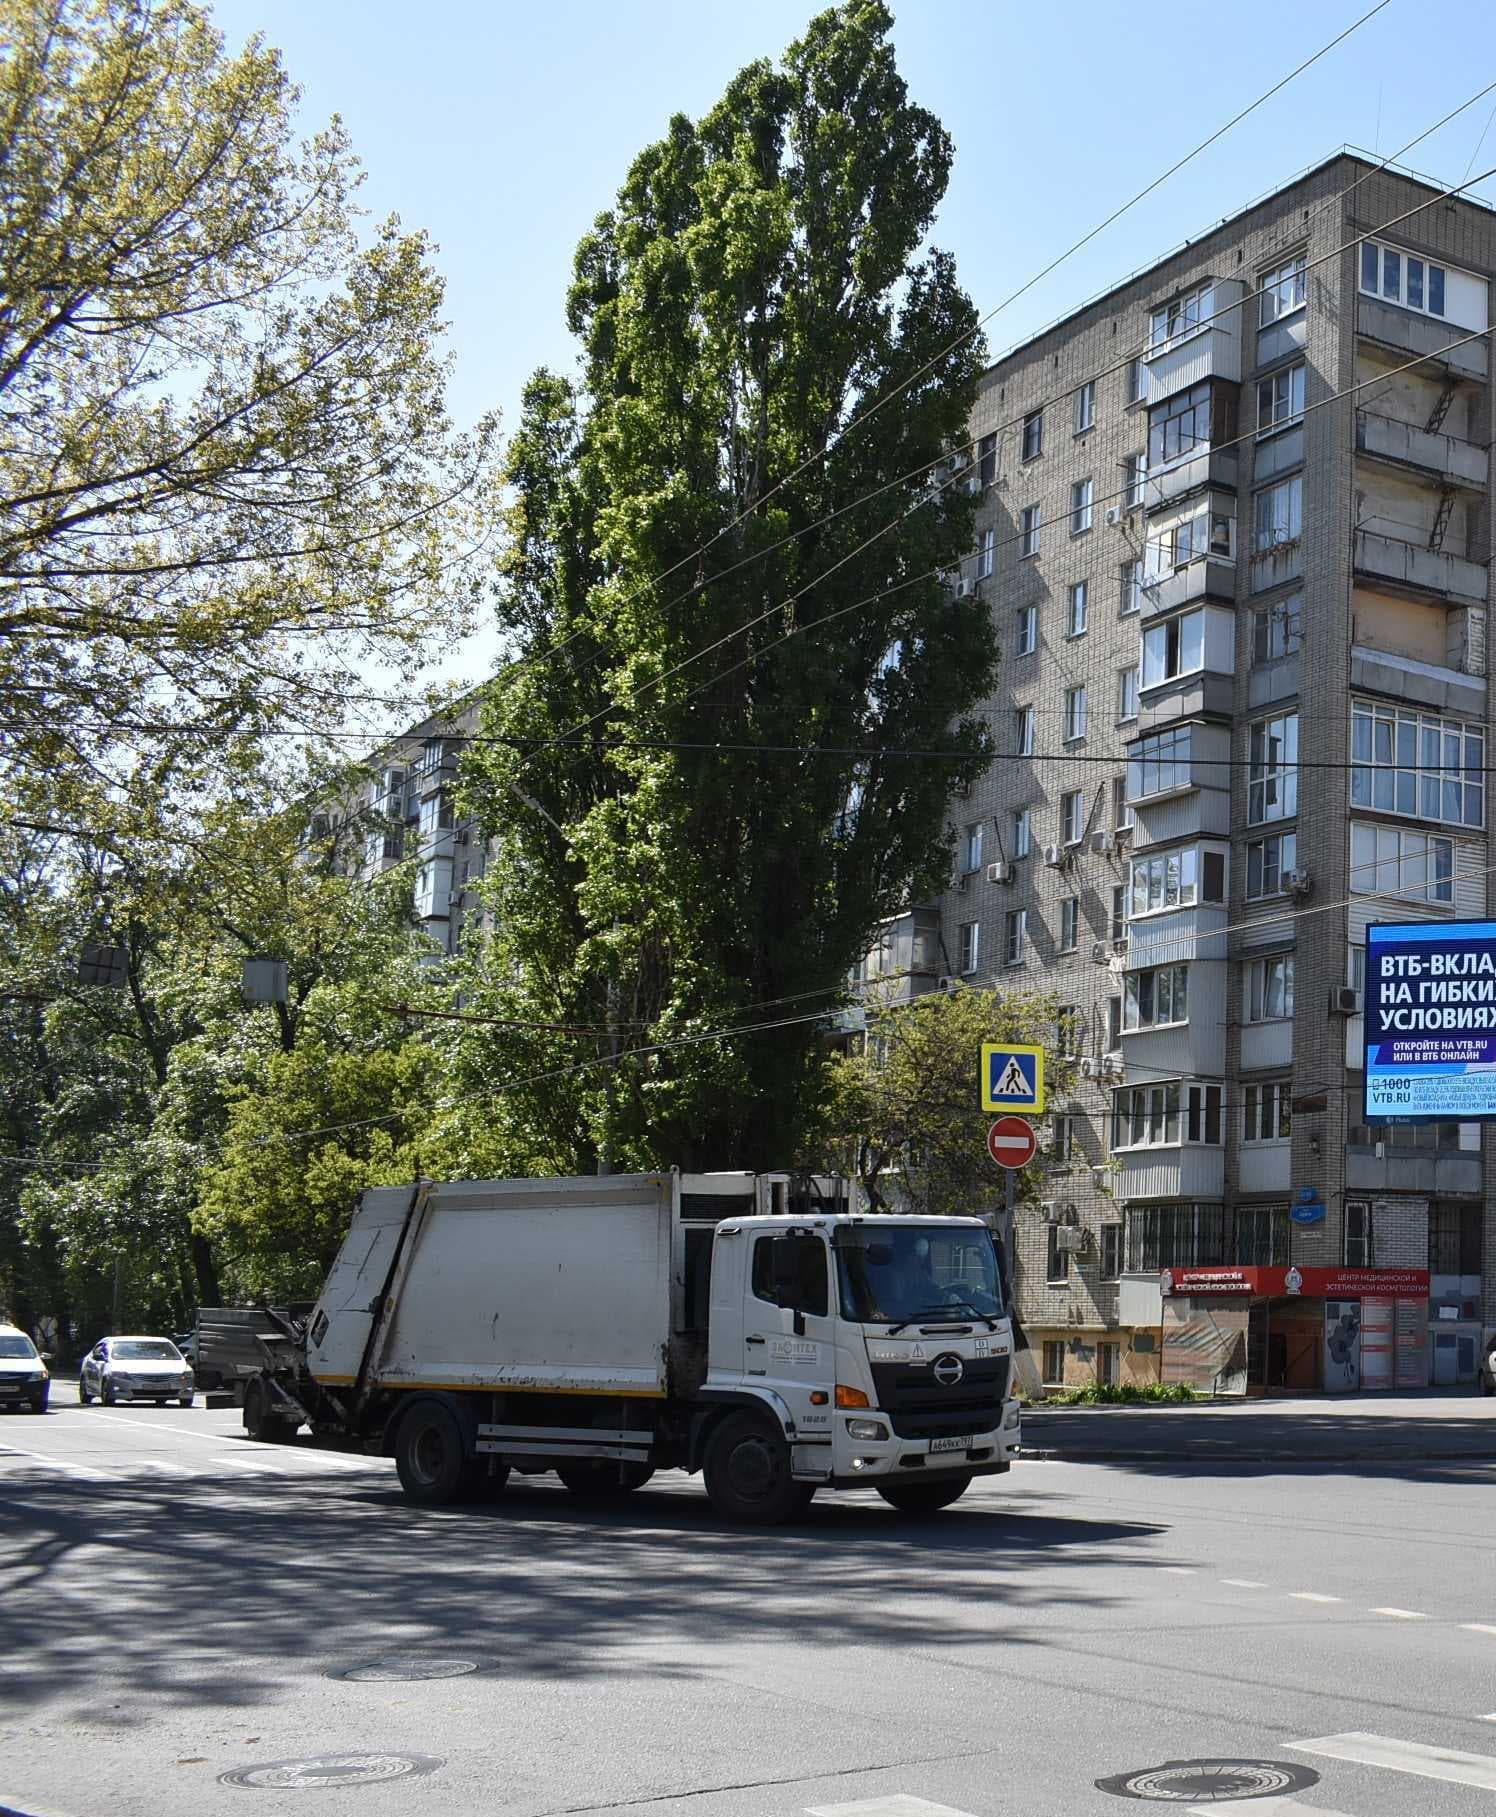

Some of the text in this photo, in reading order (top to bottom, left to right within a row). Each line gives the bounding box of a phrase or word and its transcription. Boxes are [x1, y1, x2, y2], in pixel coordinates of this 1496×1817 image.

[1380, 982, 1413, 1004] НА
[1393, 1039, 1488, 1051] ОТКРОЙТЕ НА VTB.RU
[1393, 1050, 1480, 1062] ИЛИ В ВТБ ОНЛАЙН
[1383, 1079, 1411, 1090] 1000
[1372, 1093, 1411, 1104] VTB.RU
